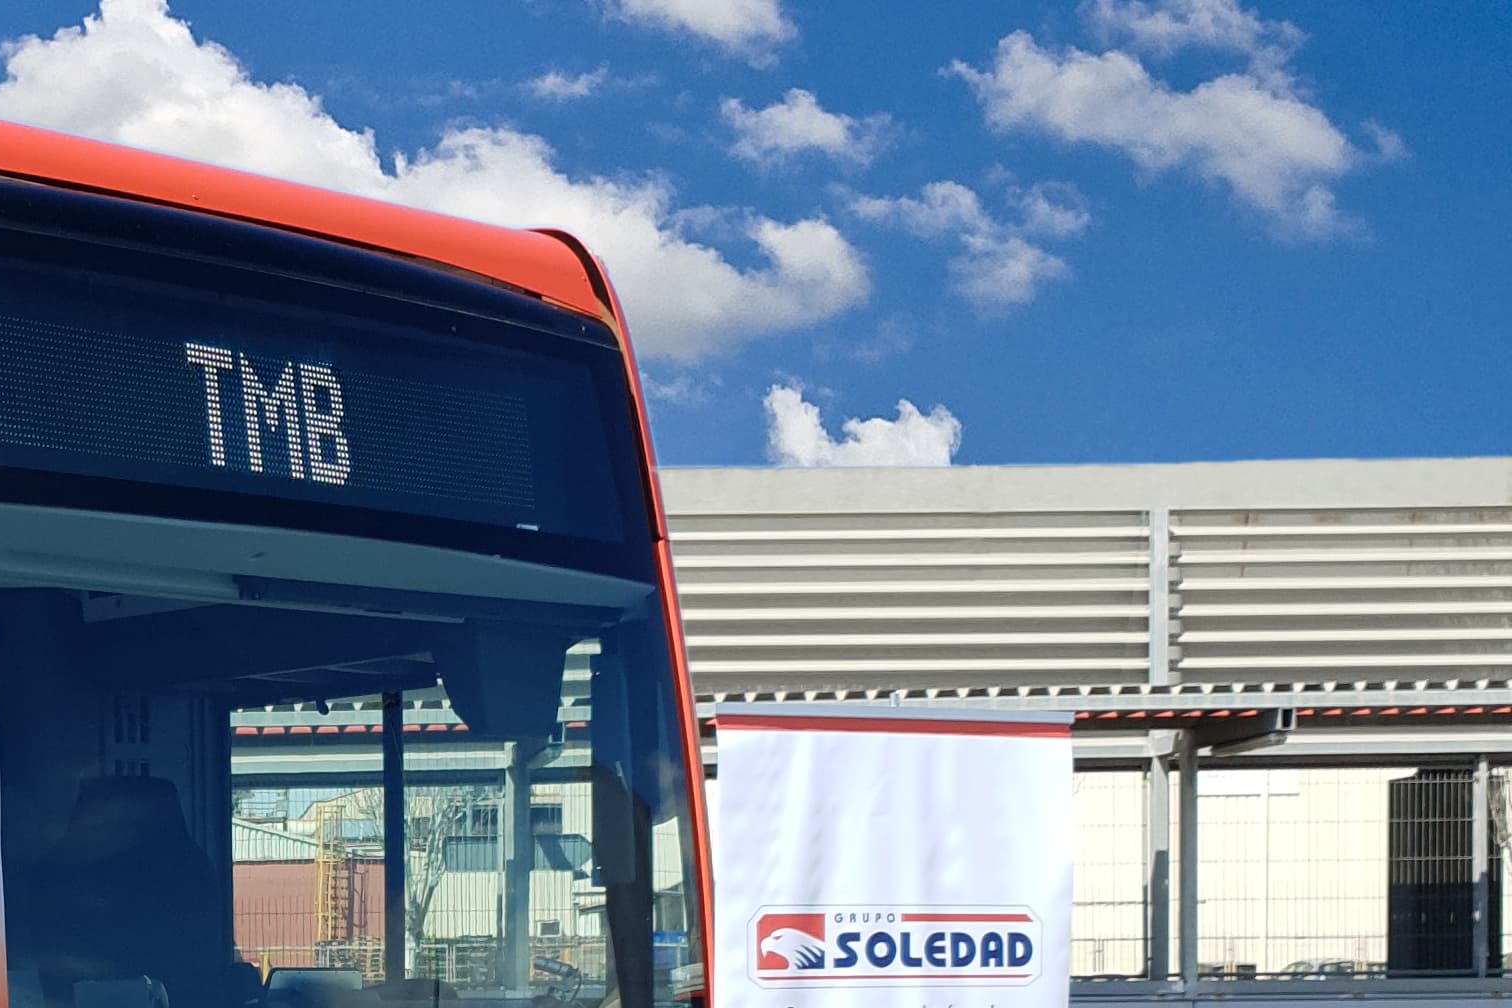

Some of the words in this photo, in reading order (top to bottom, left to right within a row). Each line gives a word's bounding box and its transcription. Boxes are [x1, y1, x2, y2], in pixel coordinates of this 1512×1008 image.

[185, 342, 350, 485] TMB
[833, 912, 896, 924] GRUPO
[832, 931, 1034, 969] SOLEDAD
